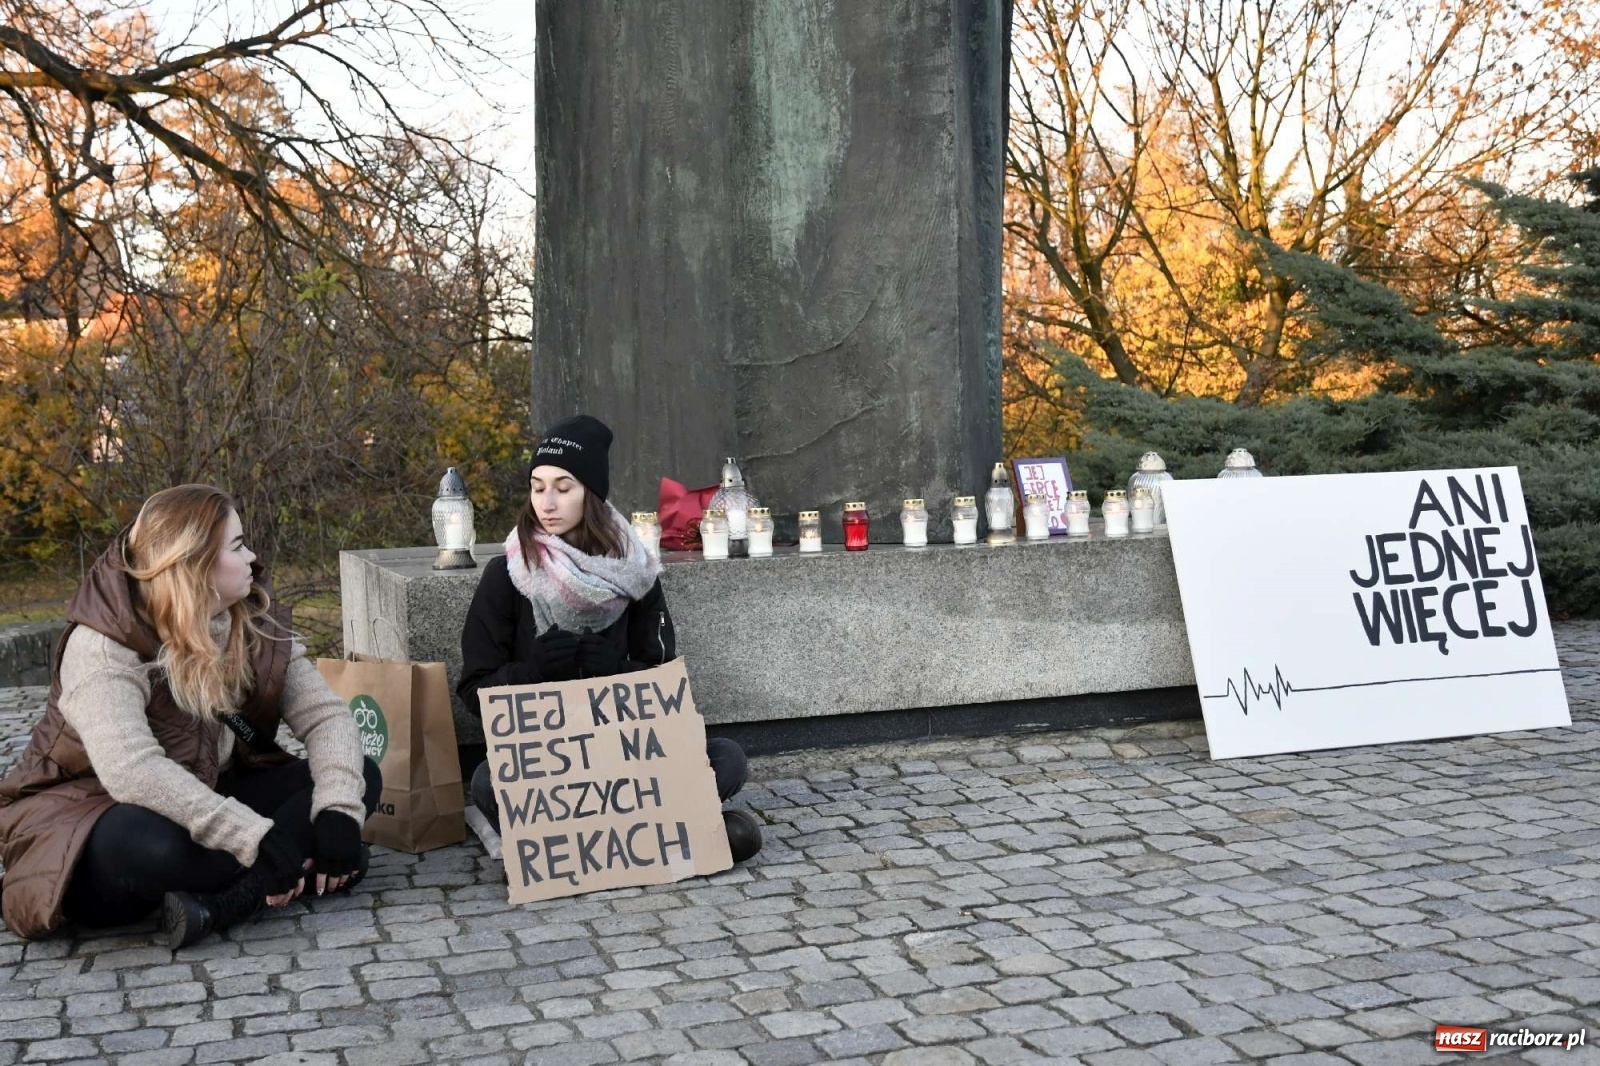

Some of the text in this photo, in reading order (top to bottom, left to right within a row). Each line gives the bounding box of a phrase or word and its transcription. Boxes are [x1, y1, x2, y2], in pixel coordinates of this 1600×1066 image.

[1024, 465, 1045, 480] JEJ
[1408, 473, 1509, 529] ANI
[1349, 524, 1535, 588] JEDNEJ
[1352, 579, 1538, 656] WIĘCEJ
[488, 677, 687, 737] JEJ KREW
[494, 727, 667, 783] JEST NA
[500, 777, 662, 829] WASZYCH
[517, 822, 691, 886] RĘKACH
